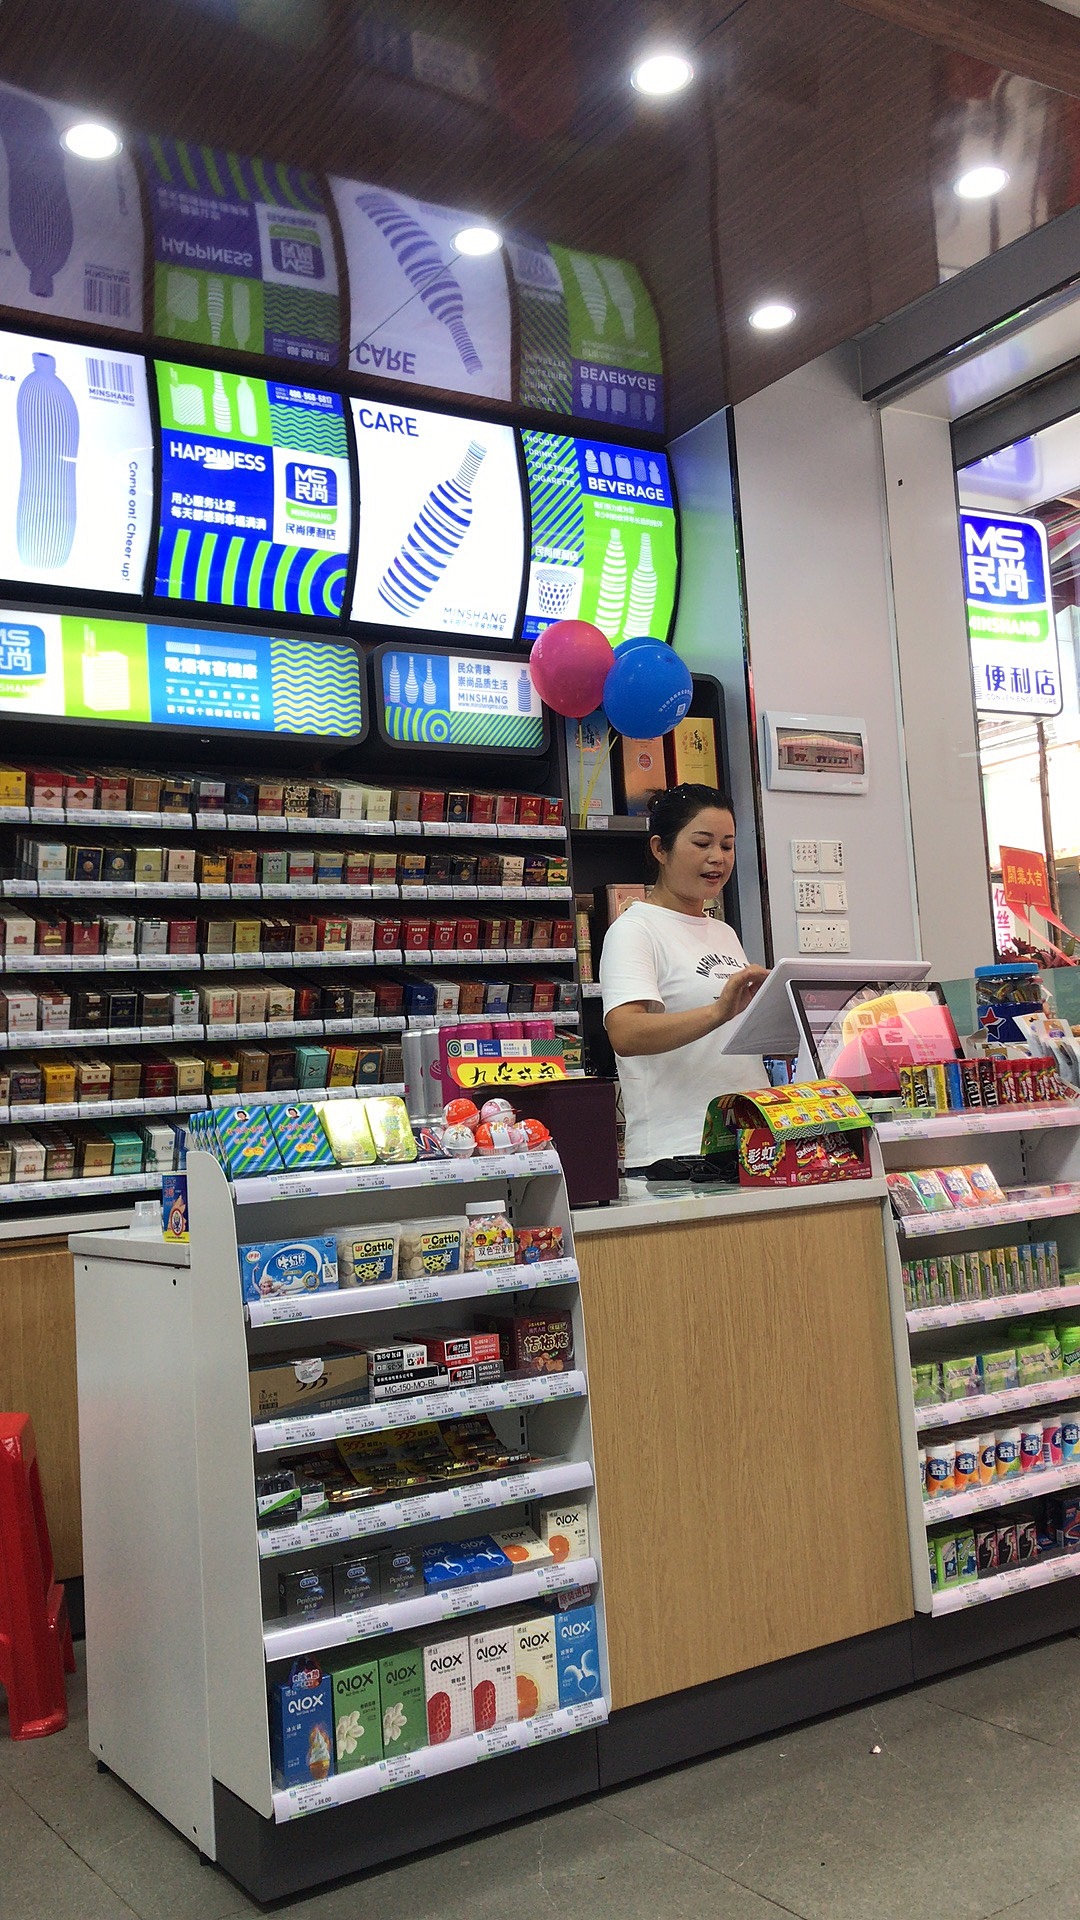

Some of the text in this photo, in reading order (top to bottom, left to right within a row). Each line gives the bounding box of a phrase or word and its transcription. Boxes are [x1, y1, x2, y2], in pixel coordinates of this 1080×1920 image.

[89, 387, 135, 402] MINSHANG
[359, 408, 419, 437] CARE
[526, 435, 560, 448] NOODLE
[170, 441, 266, 472] HAPPINESS
[529, 448, 558, 459] DRINKS
[294, 466, 328, 485] MS
[530, 461, 575, 475] TOILETRIES
[532, 474, 575, 488] CIGARETTE
[587, 476, 665, 501] BEVERAGE
[295, 481, 328, 503] 民尚
[121, 461, 138, 581] Come on! Cheer up!
[964, 522, 1026, 561] MS
[967, 555, 1029, 600] 民尚
[444, 607, 507, 624] MINSHANG
[164, 656, 258, 680] 吸烟有害健康
[457, 676, 508, 691] 崇尚品质生活
[985, 663, 1056, 696] 便利店
[458, 693, 508, 705] MINSHANG
[695, 953, 742, 978] MARINA DEL
[748, 1145, 776, 1164] 彩虹
[364, 1240, 393, 1253] Cattle
[431, 1234, 459, 1246] Cattle
[296, 1595, 324, 1605] Performa
[561, 1620, 591, 1638] NOX
[519, 1631, 550, 1650] NOX
[476, 1642, 508, 1661] NOX
[430, 1653, 462, 1672] NOX
[336, 1670, 374, 1695] NOX
[385, 1664, 417, 1685] NOX
[288, 1693, 324, 1714] NOX
